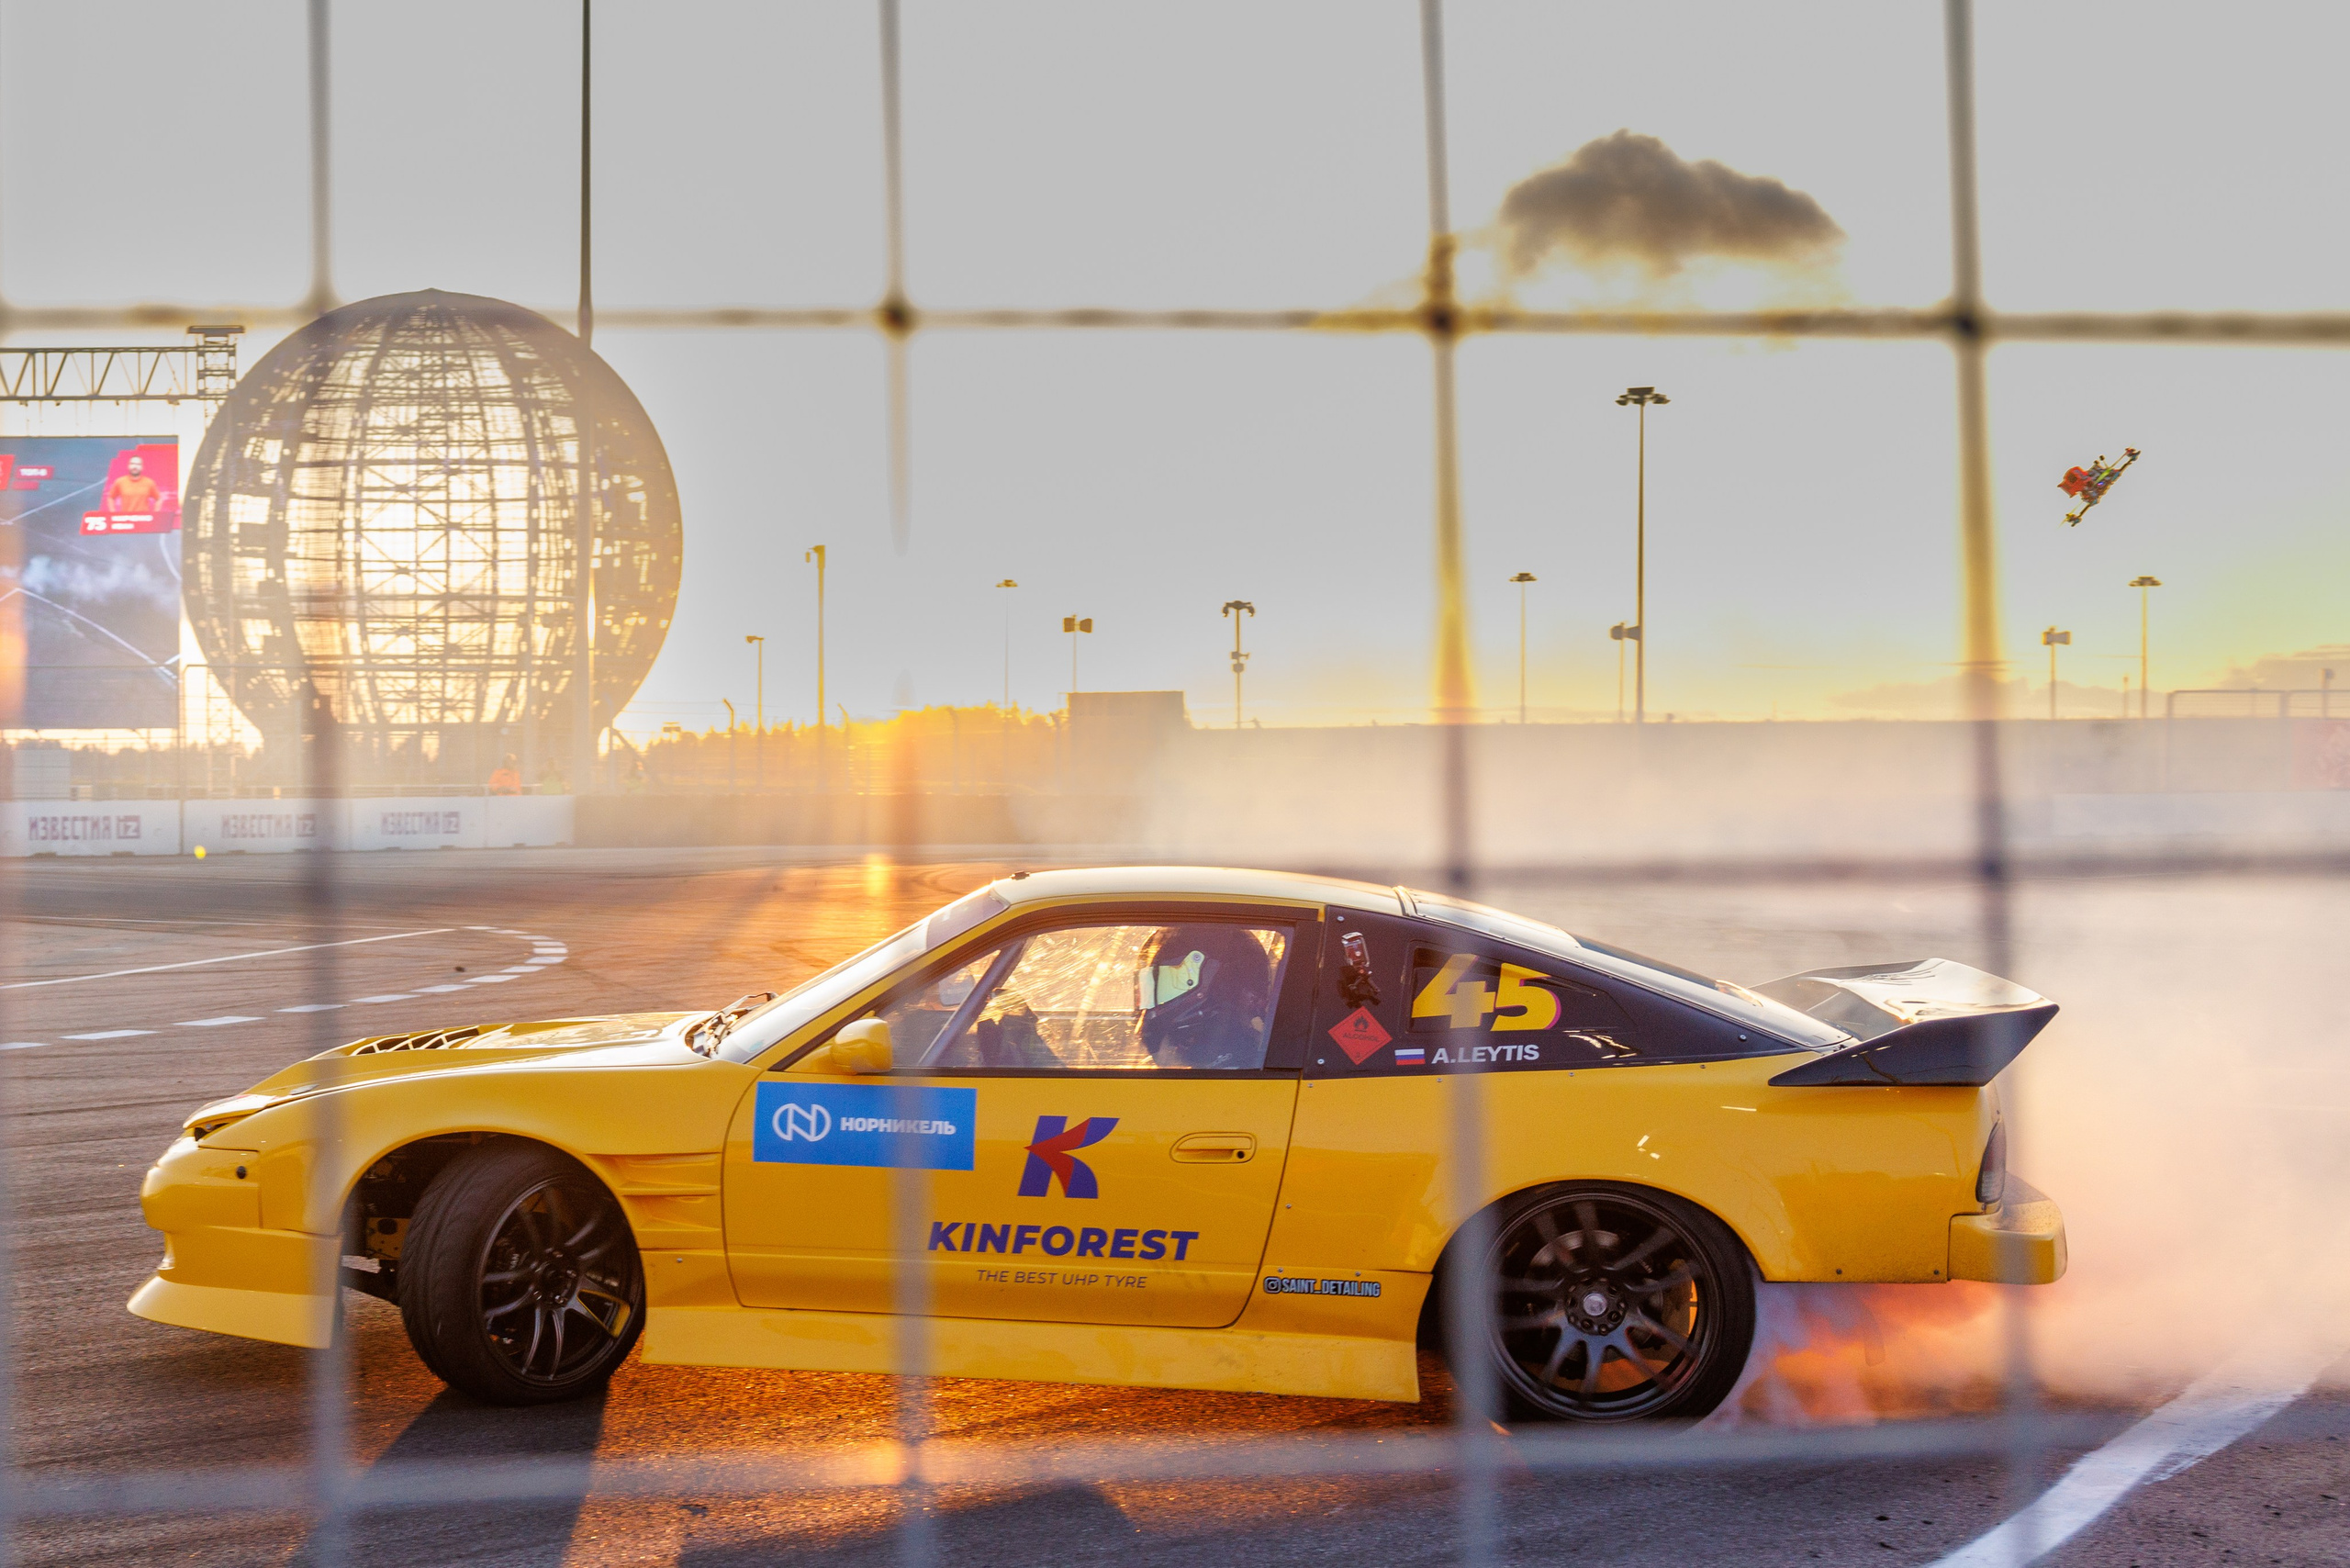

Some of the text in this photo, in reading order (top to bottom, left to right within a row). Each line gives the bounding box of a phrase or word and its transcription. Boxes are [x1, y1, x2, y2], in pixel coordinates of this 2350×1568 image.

[28, 816, 112, 840] ИЗВЕСТИЯ
[1411, 953, 1561, 1032] 45
[1431, 1044, 1539, 1064] A.LEYTIS
[840, 1116, 957, 1136] НОРНИКЕЛЬ
[927, 1221, 1200, 1261] KINFOREST
[977, 1270, 1148, 1289] THE BEST UHP TYRE
[1281, 1277, 1381, 1297] SAINT_DETAILING
